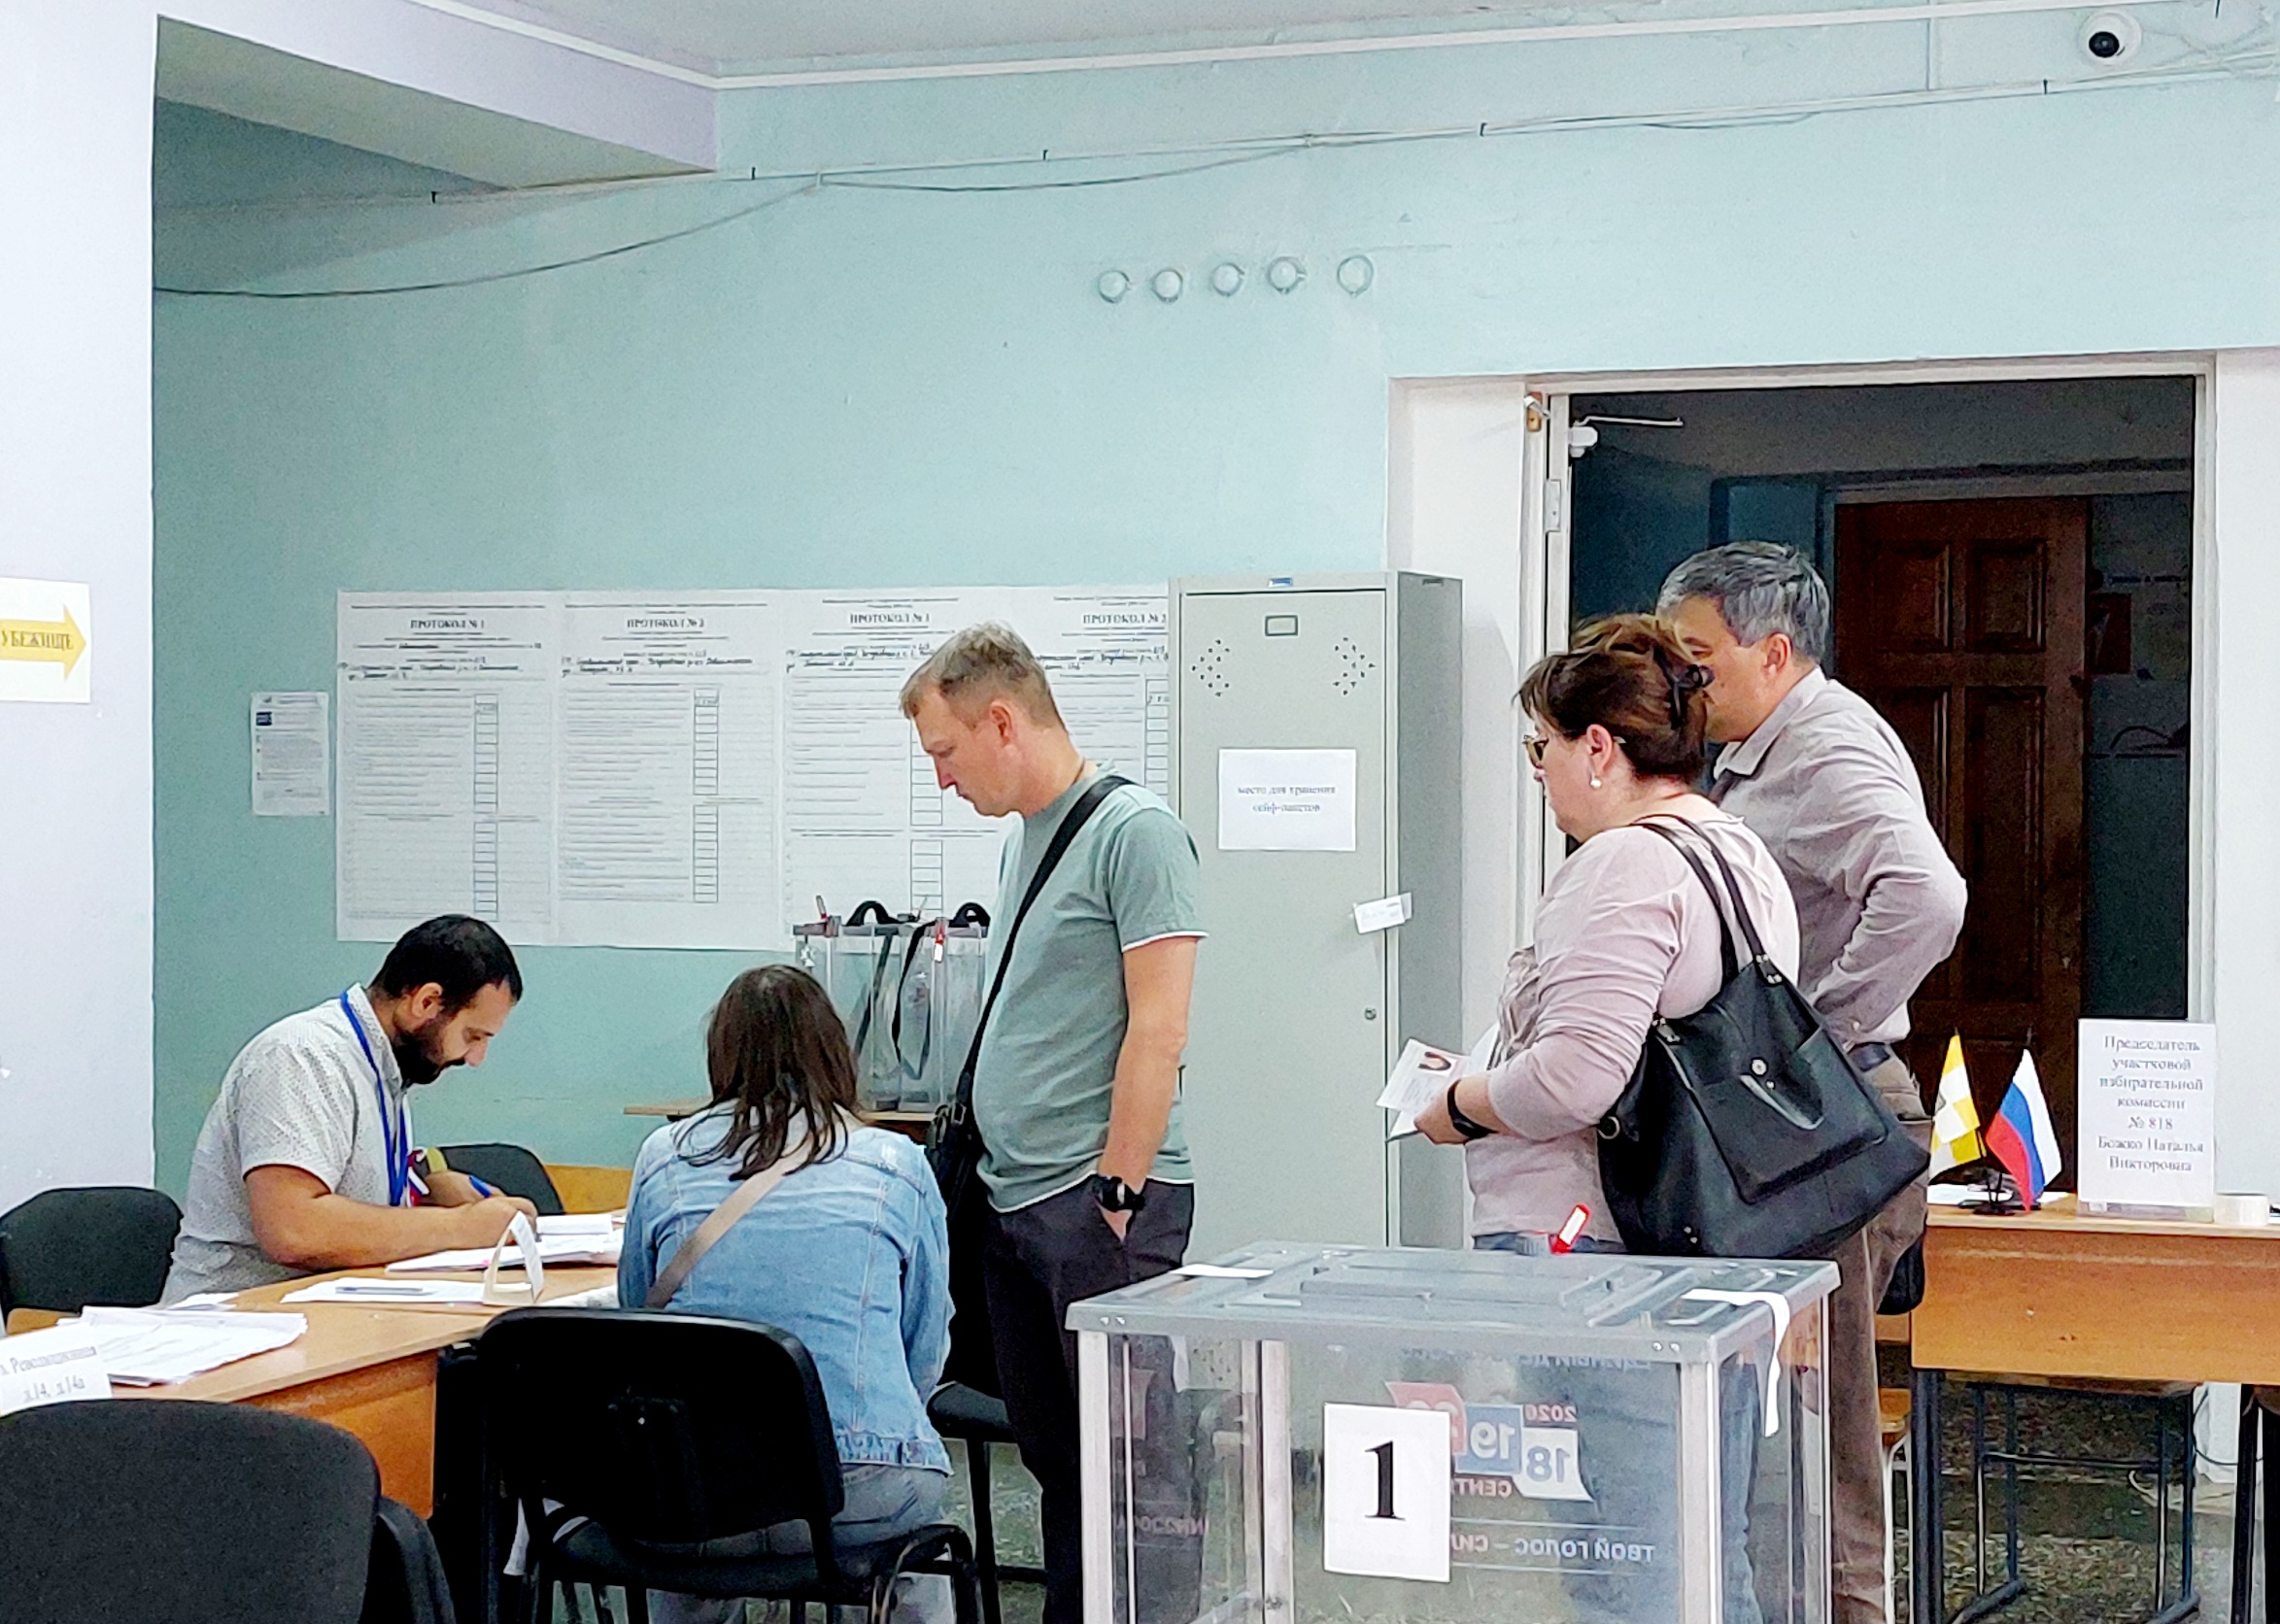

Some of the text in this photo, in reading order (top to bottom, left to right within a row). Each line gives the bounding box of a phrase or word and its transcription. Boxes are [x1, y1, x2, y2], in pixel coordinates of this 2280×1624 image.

[410, 619, 466, 629] ПРОТОКОЛ
[627, 618, 685, 628] ПРОТОКОЛ
[850, 613, 910, 625] ПРОТОКОЛ
[1082, 613, 1145, 625] ПРОТОКОЛ
[1, 629, 74, 652] УБЕЖИЩЕ
[2104, 1034, 2201, 1052] Председатель
[2111, 1058, 2192, 1071] участковой
[2098, 1075, 2204, 1092] избирательной
[2117, 1097, 2186, 1109] комиссии
[2148, 1117, 2174, 1131] 818
[2147, 1136, 2204, 1153] Наталья
[2109, 1155, 2193, 1173] Викторовна
[1363, 1439, 1407, 1521] 1
